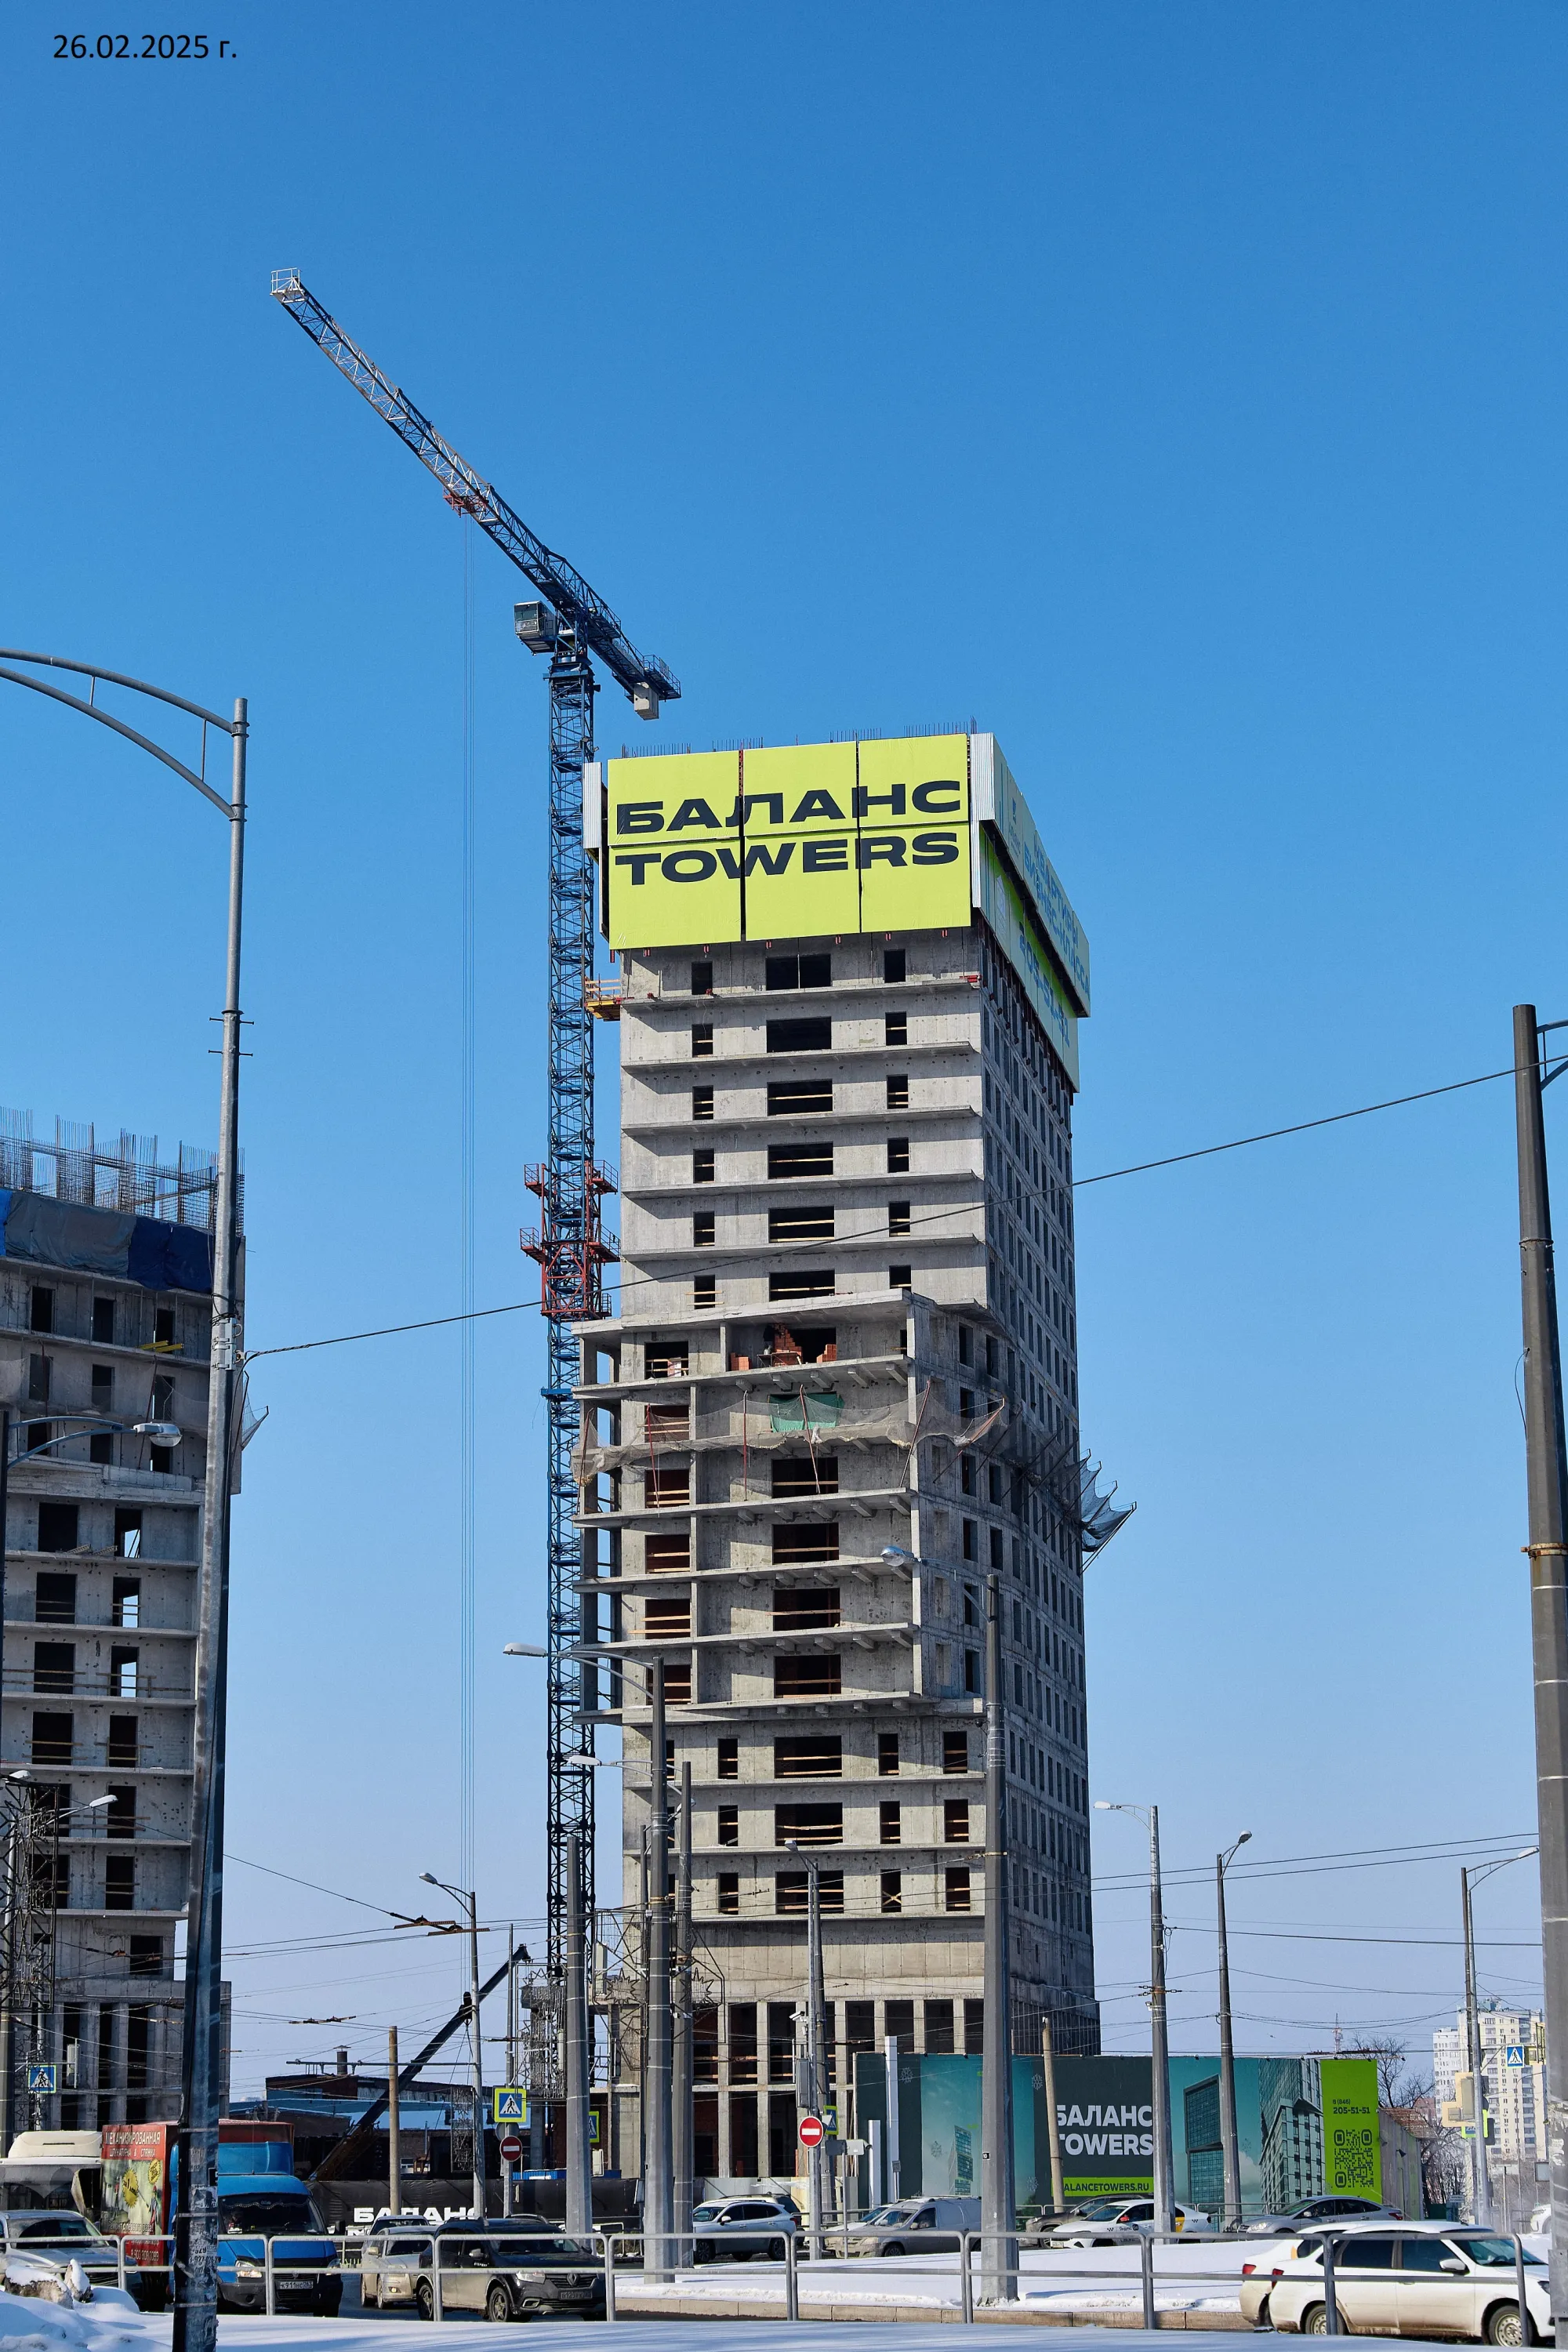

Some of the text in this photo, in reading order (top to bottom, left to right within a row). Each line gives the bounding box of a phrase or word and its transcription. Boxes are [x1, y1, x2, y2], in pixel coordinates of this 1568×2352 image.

[616, 780, 961, 836] БАЛАНС
[615, 832, 960, 886] TOWERS
[106, 2132, 161, 2145] МЕХАНИЗИРОВАННАЯ
[1059, 2133, 1153, 2156] OWERS
[1064, 2183, 1149, 2192] ALANCETOWERS.RU
